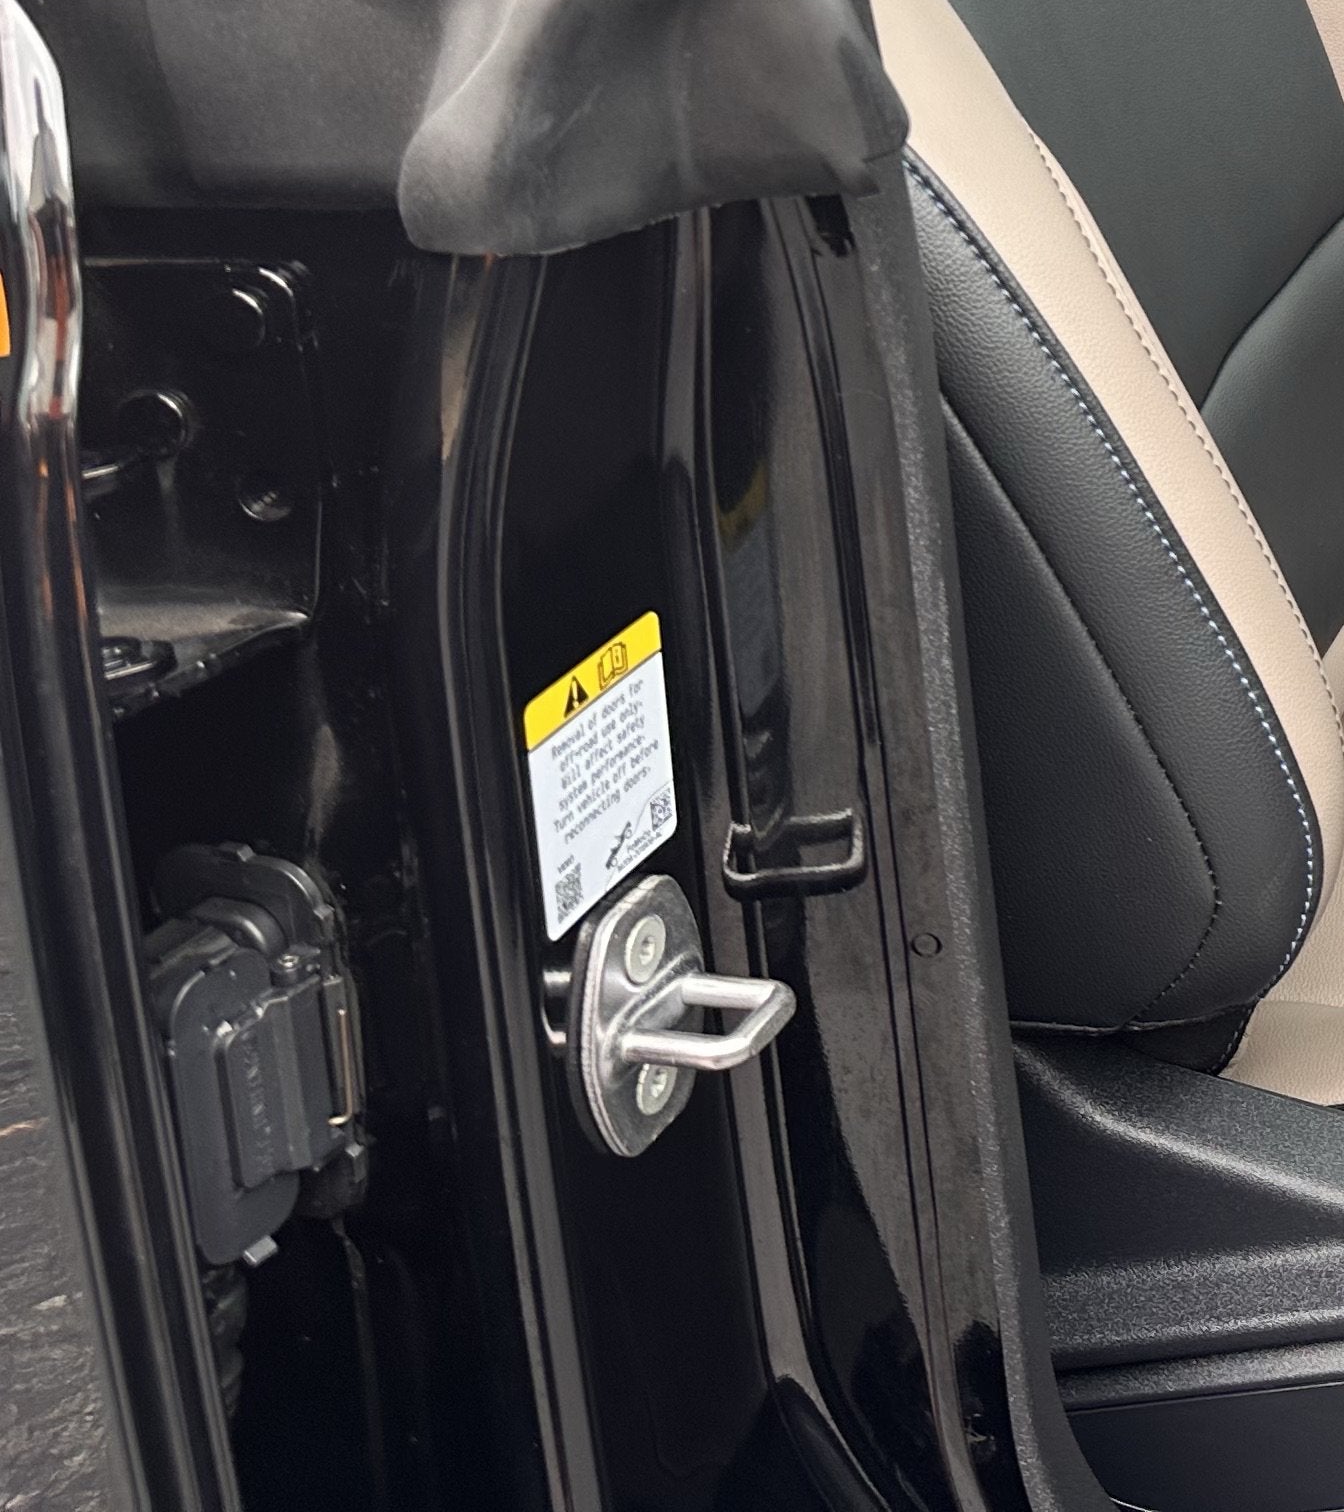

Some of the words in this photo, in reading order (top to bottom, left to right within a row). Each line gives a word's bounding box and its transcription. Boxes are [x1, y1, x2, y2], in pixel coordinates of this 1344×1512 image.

[552, 723, 585, 761] Removal
[588, 712, 598, 731] of
[601, 693, 626, 719] doors
[629, 679, 643, 697] for
[559, 731, 598, 773] off-road
[601, 719, 616, 738] use
[585, 739, 613, 771] affect
[617, 715, 645, 744] safety
[553, 811, 575, 833] Turn
[577, 779, 610, 814] vehicle
[613, 762, 627, 784] off
[630, 739, 659, 769] before
[559, 780, 588, 812] system
[564, 789, 621, 845] reconnecting
